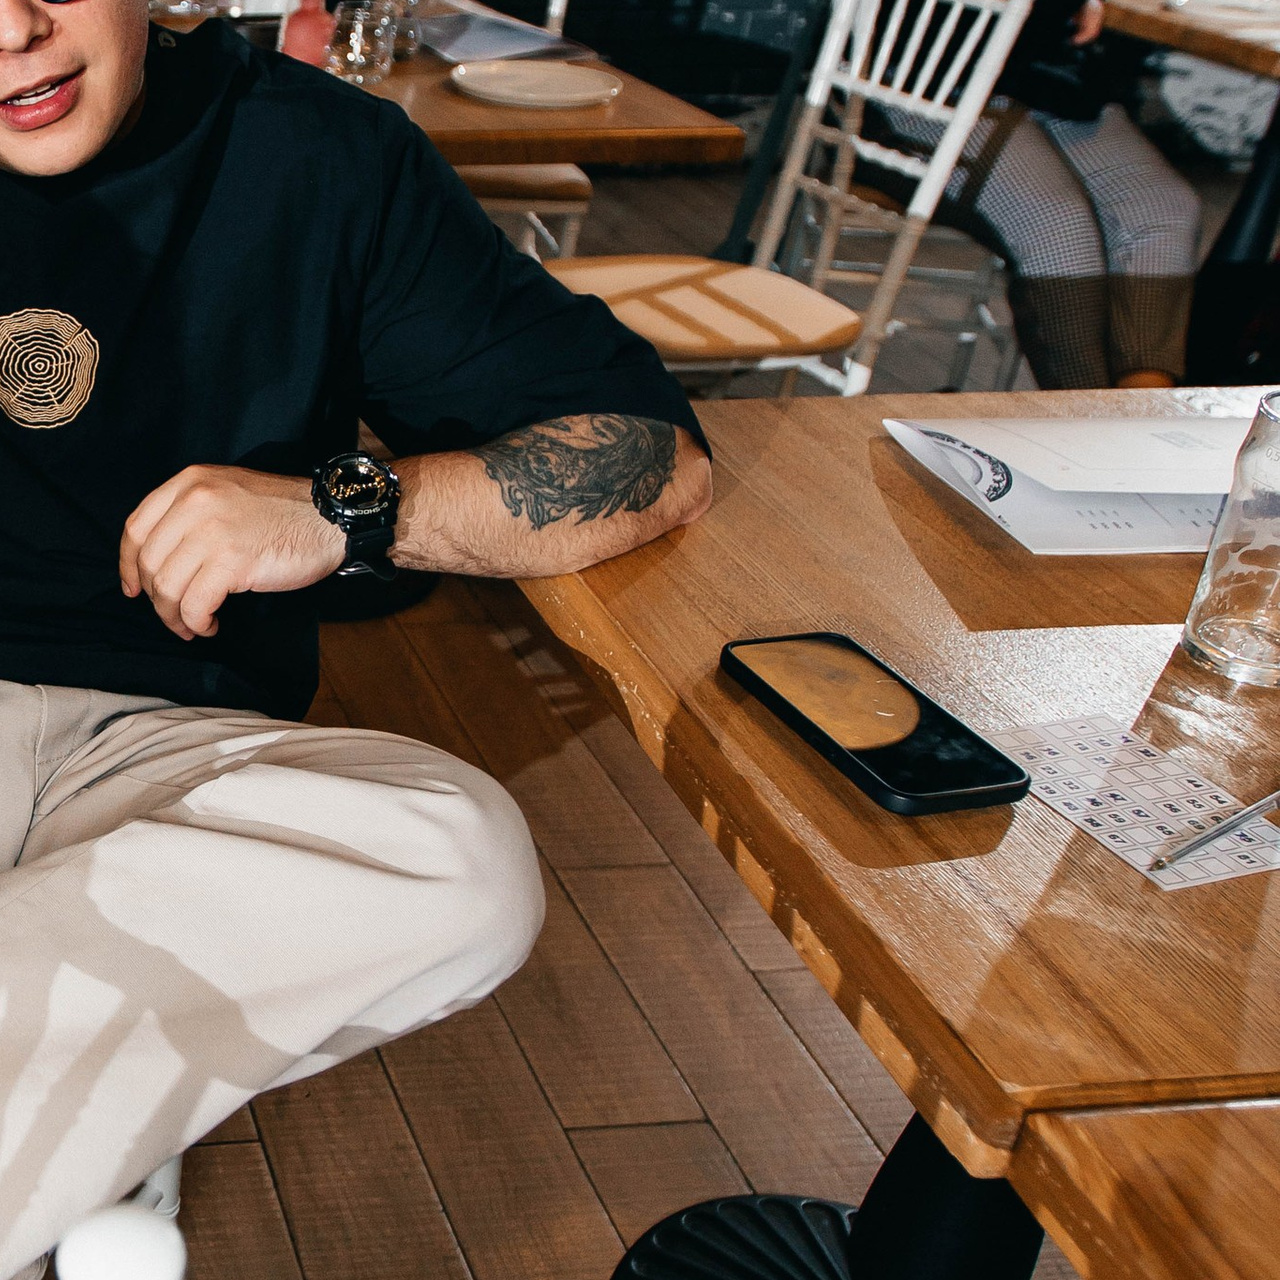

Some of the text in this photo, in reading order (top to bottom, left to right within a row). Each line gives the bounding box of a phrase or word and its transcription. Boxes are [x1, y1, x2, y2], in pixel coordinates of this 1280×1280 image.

[1040, 765, 1058, 775] 23
[1062, 780, 1080, 791] 32
[1186, 798, 1204, 809] 55
[1040, 785, 1057, 795] 39
[1108, 834, 1127, 844] 67
[1188, 819, 1206, 830] 69
